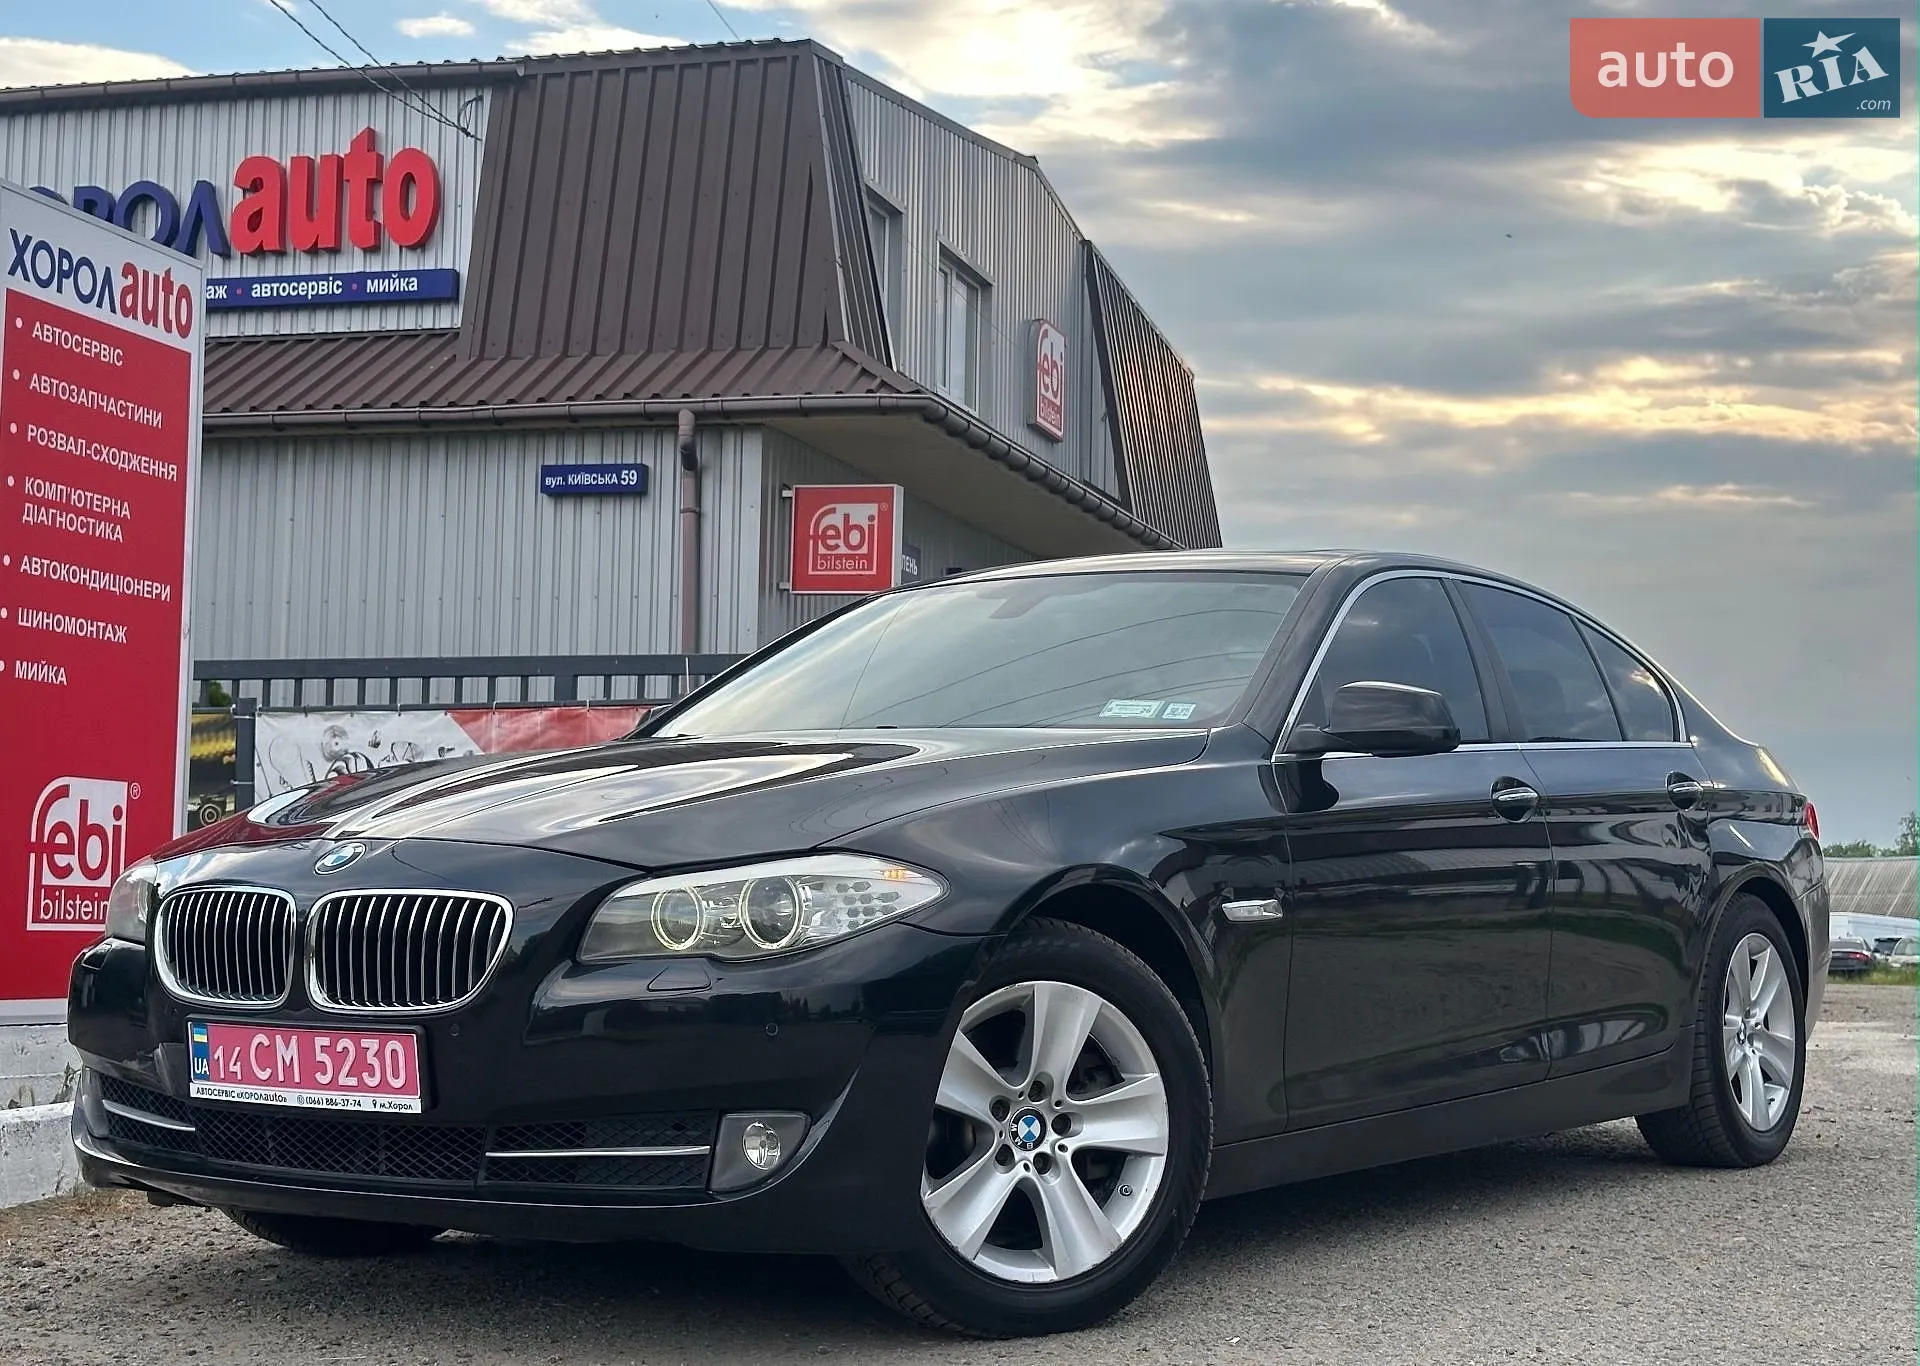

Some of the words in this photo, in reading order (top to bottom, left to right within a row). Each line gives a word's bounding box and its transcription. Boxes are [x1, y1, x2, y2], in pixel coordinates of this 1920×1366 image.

[206, 284, 227, 299] аж
[252, 276, 342, 299] автосервіс
[366, 274, 418, 293] мийка
[32, 321, 124, 367] АВТОСЕРВІС
[1037, 328, 1064, 400] febi
[29, 373, 163, 429] АВТОЗАПЧАСТИНИ
[27, 424, 178, 482] РОЗВАЛ-СХОДЖЕННЯ
[545, 477, 566, 488] вул.
[568, 471, 618, 485] КИЇВСЬКА
[620, 470, 638, 485] 59
[22, 502, 123, 543] ДІАГНОСТИКА
[809, 506, 876, 552] febi
[20, 555, 171, 602] АВТОКОНДИЦІОНЕРИ
[816, 556, 868, 570] bilstein
[18, 607, 128, 643] ШИНОМОНТАЖ
[15, 659, 67, 685] МИЙКА
[30, 783, 124, 880] febi
[39, 888, 110, 921] bilstein
[194, 1058, 209, 1075] UA
[214, 1045, 243, 1081] 14
[314, 1036, 407, 1089] 5230
[196, 1086, 236, 1099] АВТОСЕРВІС
[305, 1096, 323, 1106] (066)
[325, 1097, 362, 1108] 886-37-74
